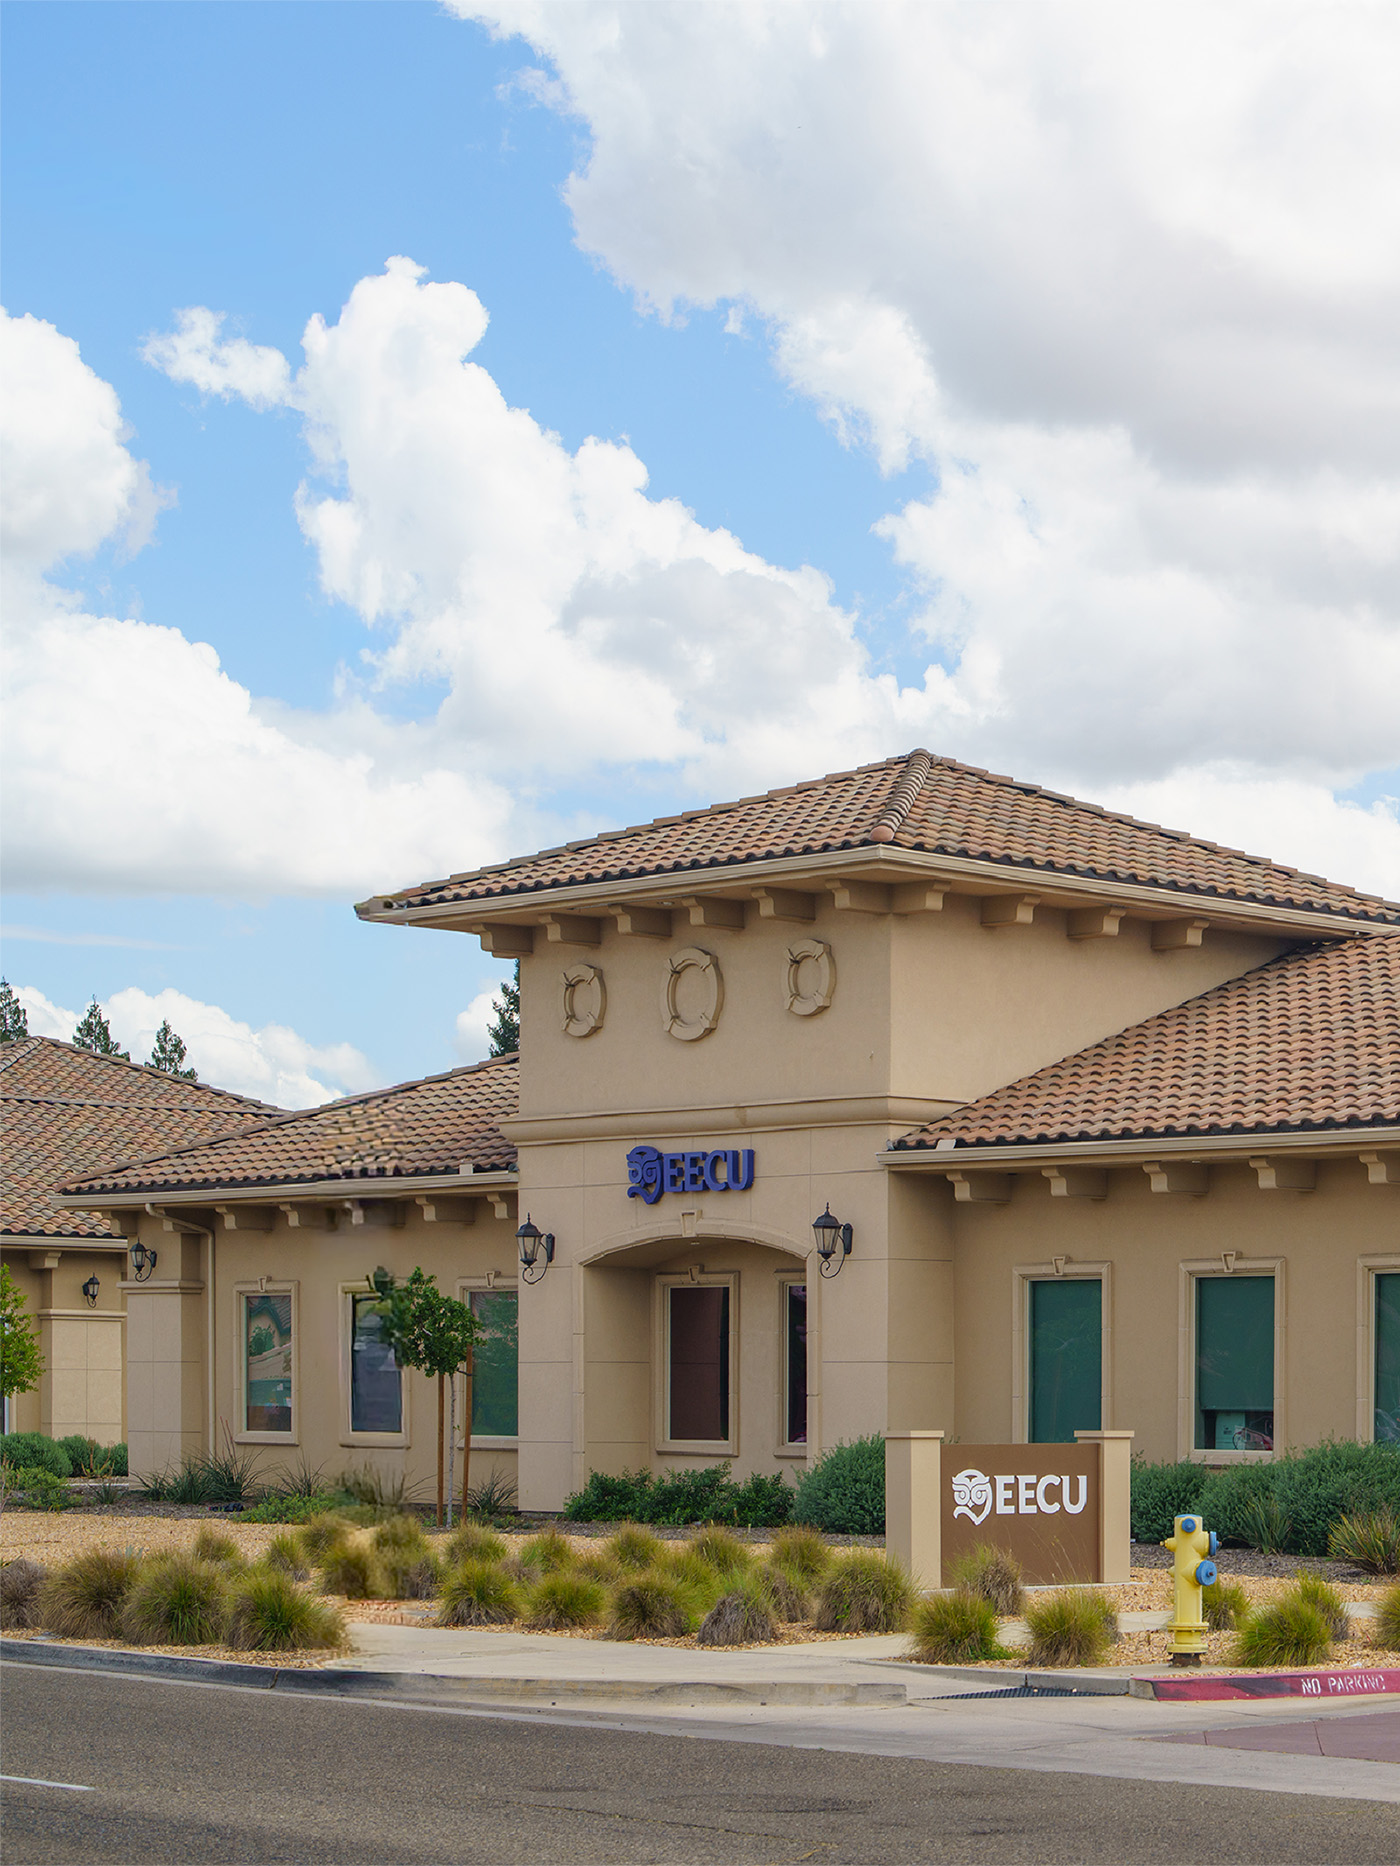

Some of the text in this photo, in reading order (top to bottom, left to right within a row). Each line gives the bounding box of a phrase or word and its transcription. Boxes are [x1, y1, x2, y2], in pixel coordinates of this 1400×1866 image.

[662, 1149, 755, 1193] EECU
[993, 1474, 1087, 1515] EECU
[1300, 1674, 1386, 1695] NO PARKING
